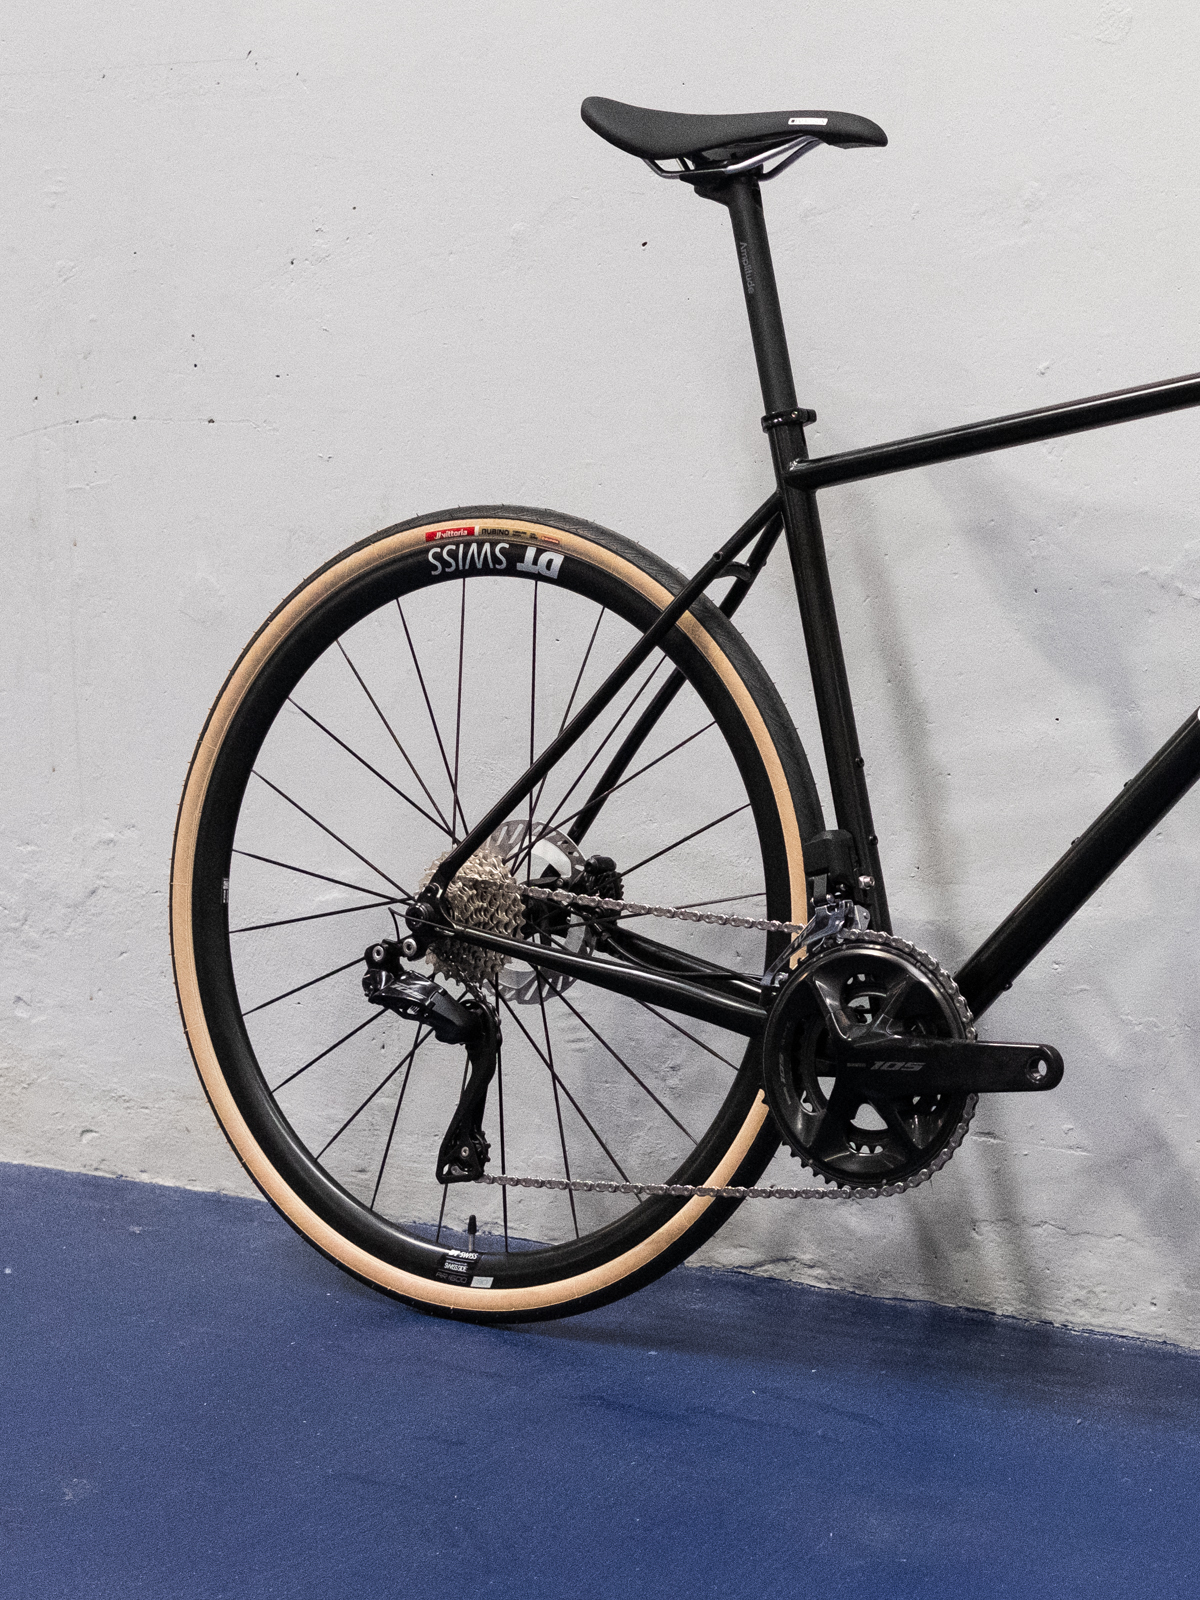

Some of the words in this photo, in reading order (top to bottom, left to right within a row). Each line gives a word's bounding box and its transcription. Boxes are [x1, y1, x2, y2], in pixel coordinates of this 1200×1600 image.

[428, 542, 509, 575] SWISS
[516, 546, 565, 579] DT
[870, 1061, 926, 1071] 105
